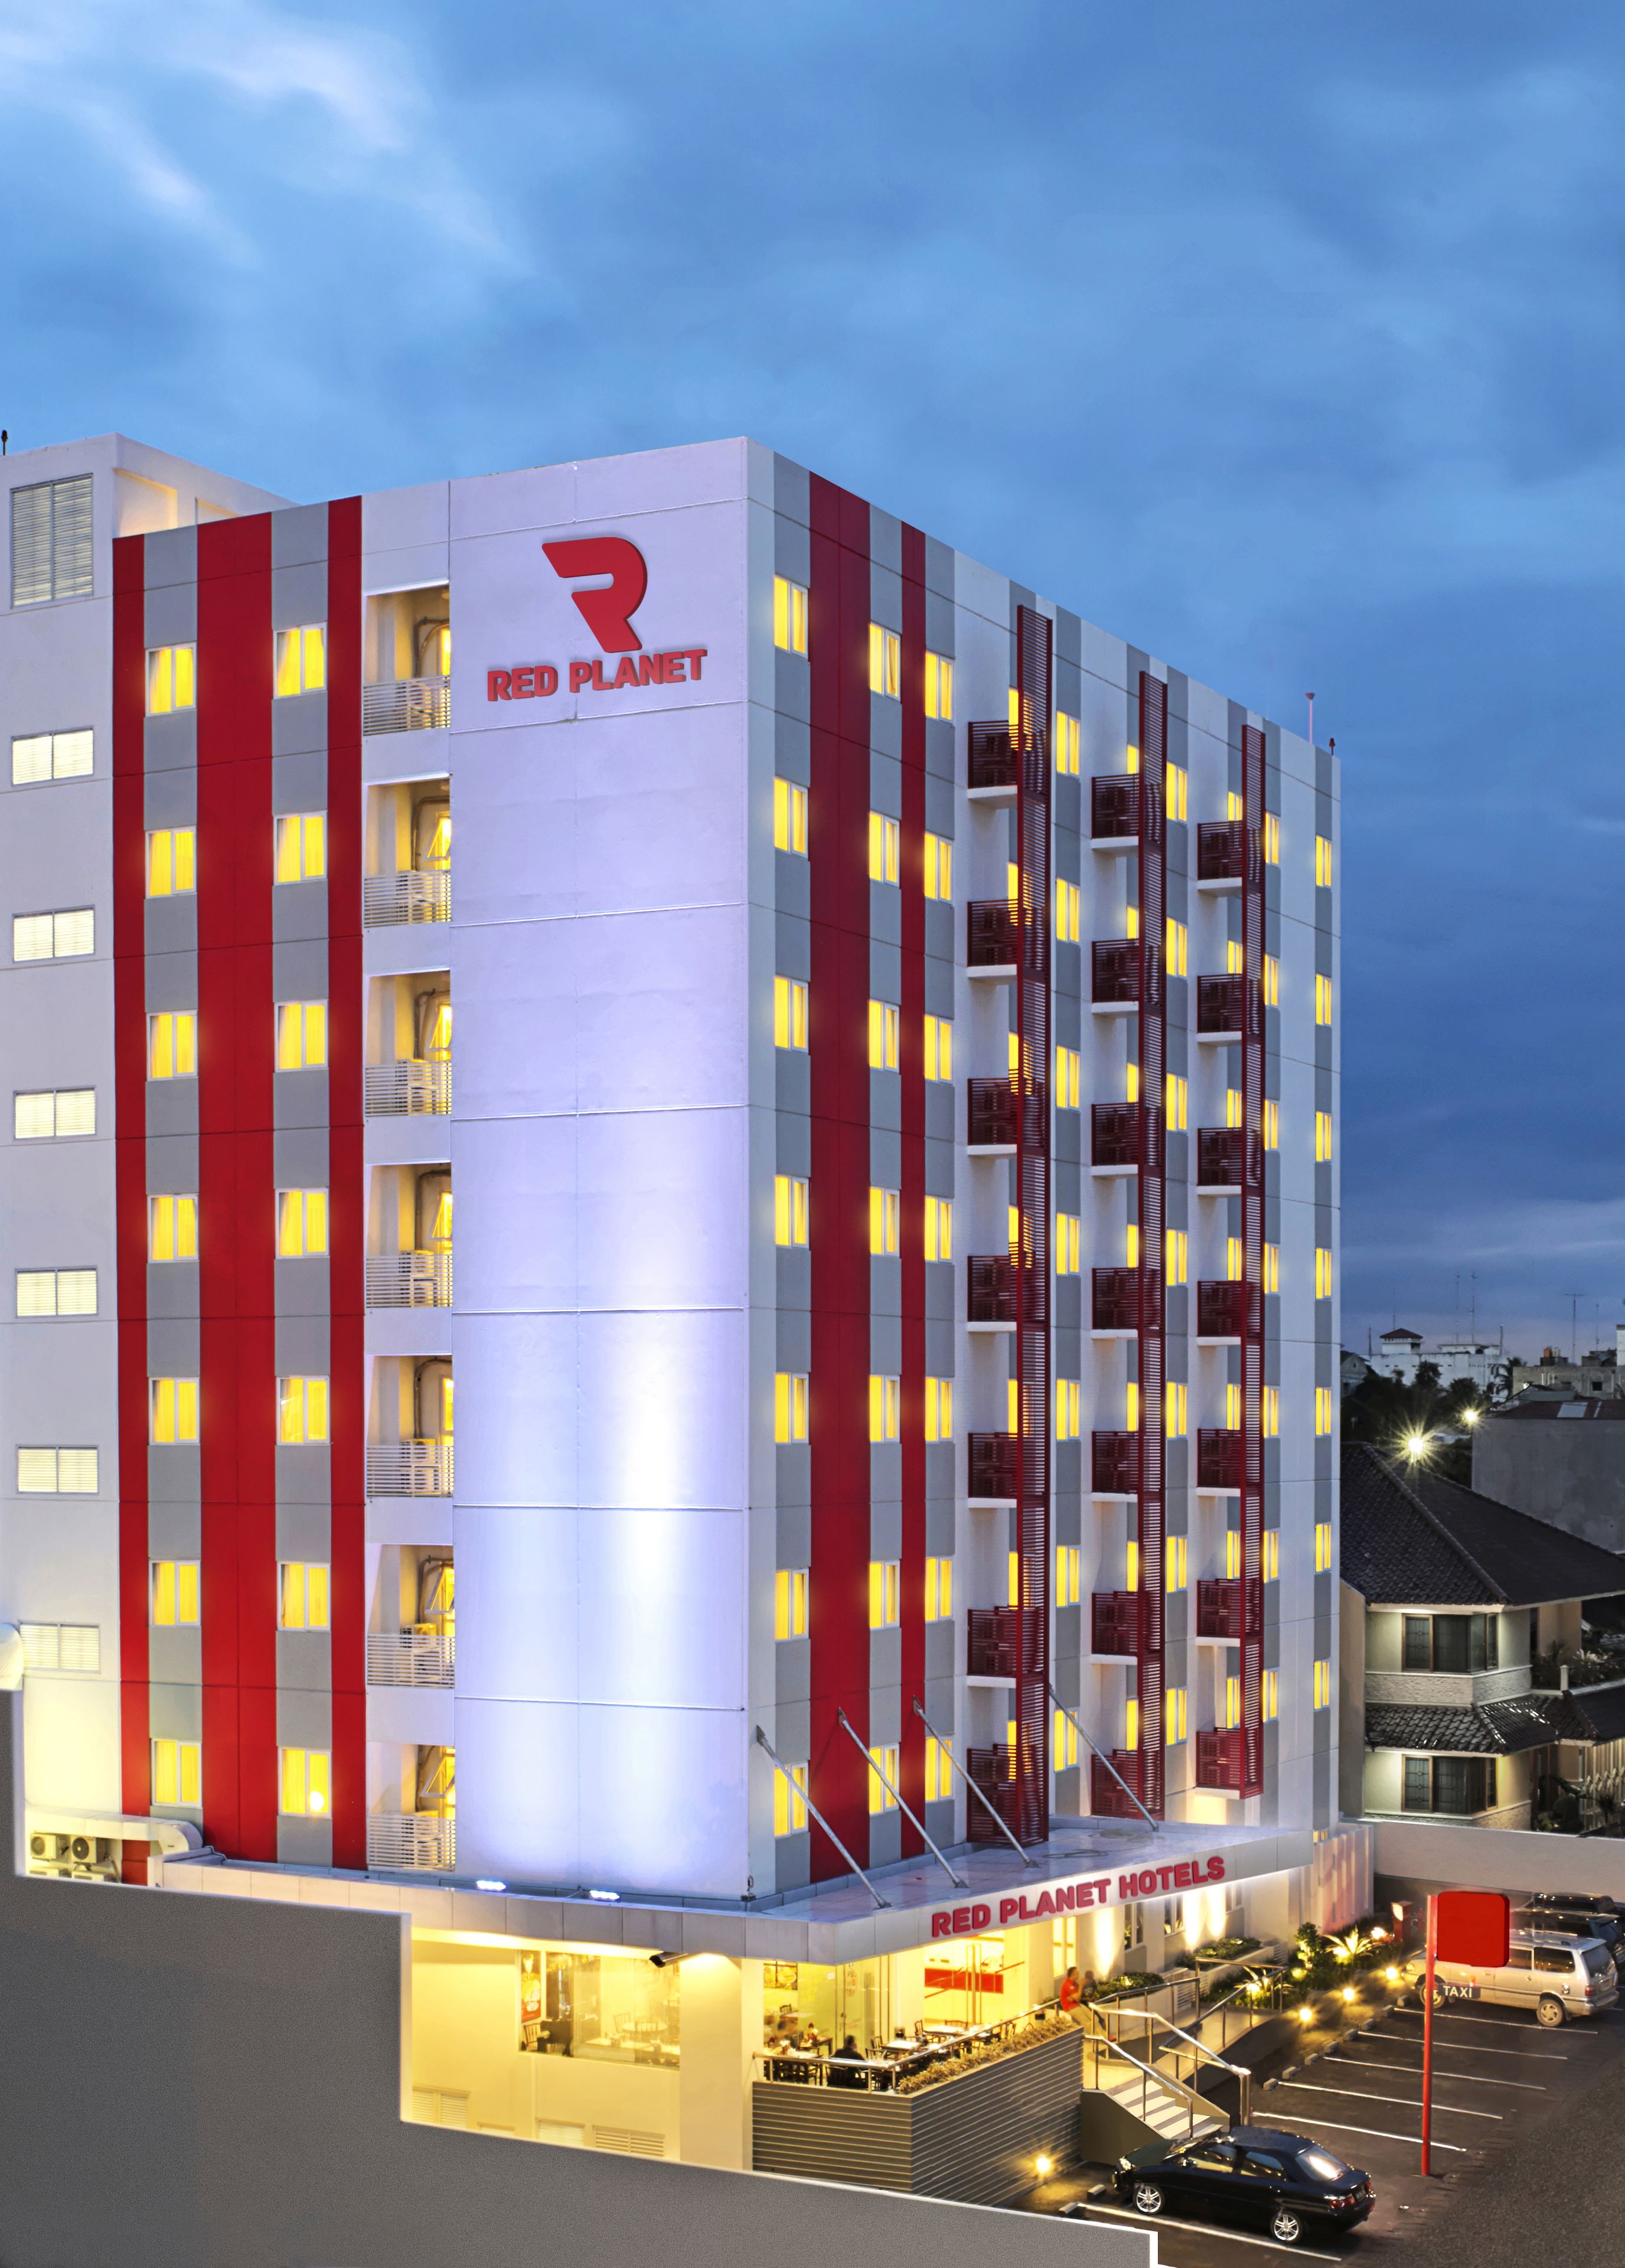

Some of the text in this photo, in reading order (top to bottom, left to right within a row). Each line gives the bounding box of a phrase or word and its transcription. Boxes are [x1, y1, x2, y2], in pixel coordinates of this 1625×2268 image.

[487, 649, 708, 702] RED PLANET
[931, 1856, 1225, 1938] RED PLANET HOTELS
[1443, 1985, 1472, 1998] TAXI
